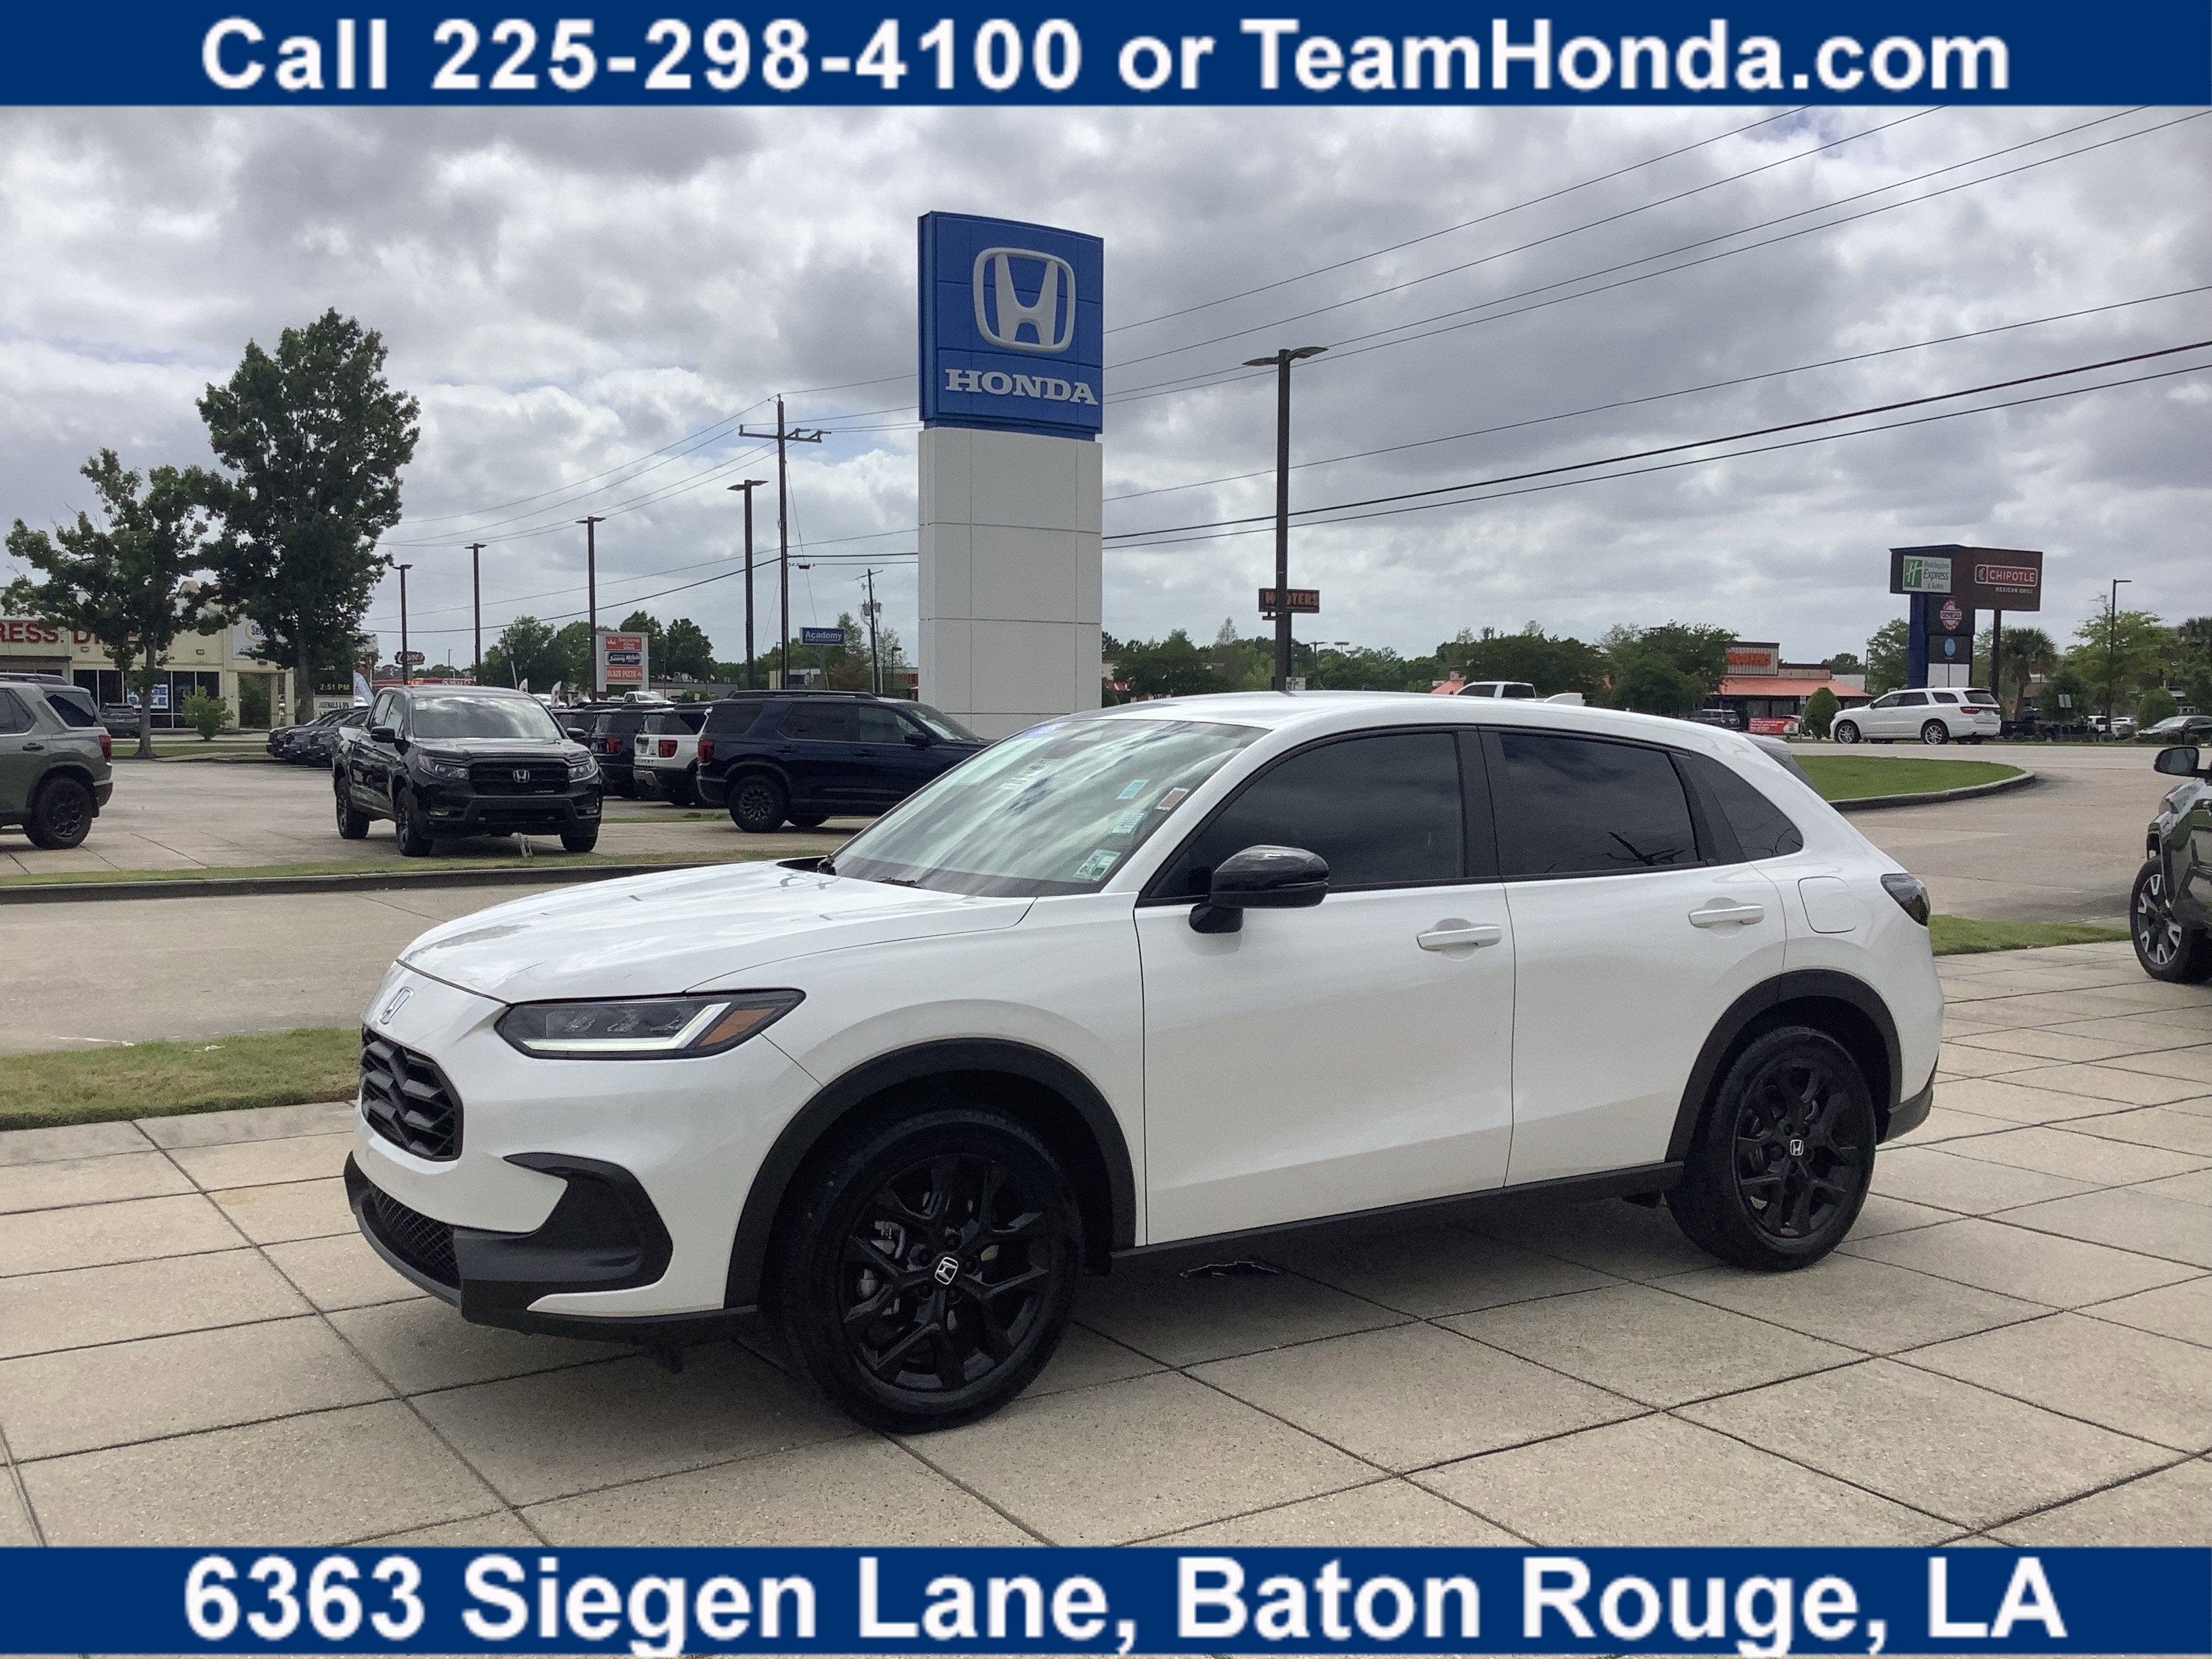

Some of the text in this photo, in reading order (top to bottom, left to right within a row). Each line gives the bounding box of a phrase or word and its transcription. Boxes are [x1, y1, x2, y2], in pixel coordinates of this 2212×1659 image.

[945, 368, 1099, 406] HONDA
[1923, 569, 1949, 581] Express
[1990, 570, 2034, 583] CHIPOTLE
[1265, 591, 1318, 605] HOTERS
[805, 630, 842, 641] Academy
